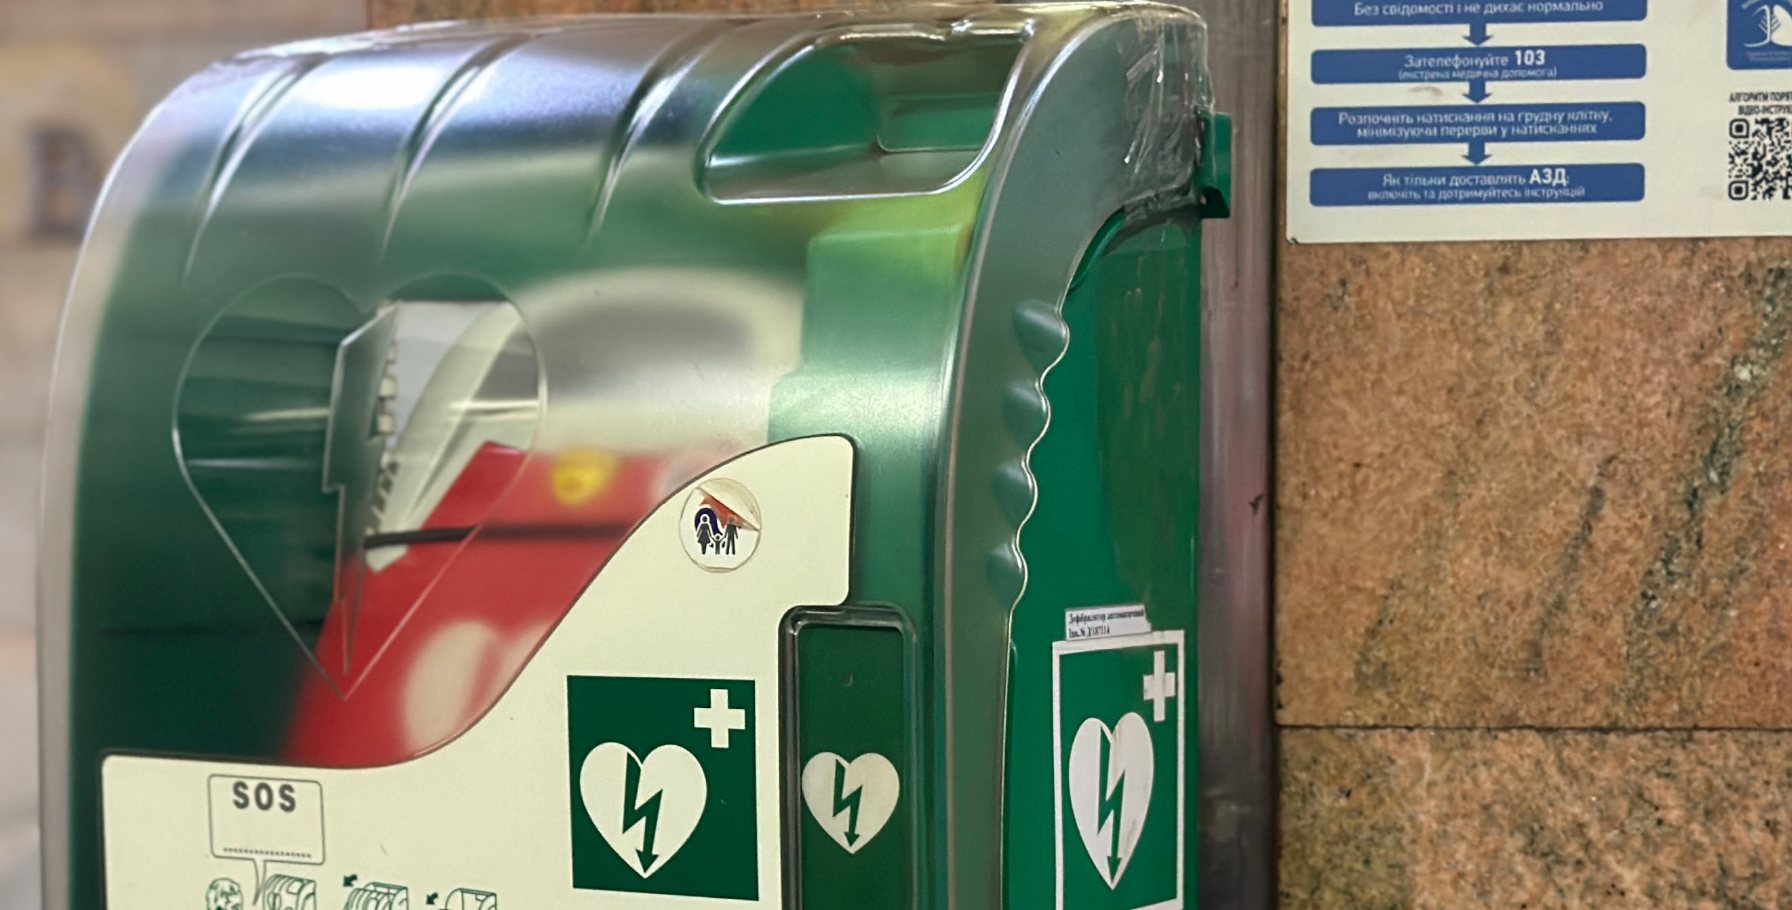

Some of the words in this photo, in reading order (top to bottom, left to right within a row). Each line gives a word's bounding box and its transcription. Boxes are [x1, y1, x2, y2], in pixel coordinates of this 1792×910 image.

[1354, 2, 1379, 16] Без
[1382, 2, 1454, 17] свідомості
[1464, 4, 1480, 13] не
[1527, 2, 1604, 14] нормально
[1404, 53, 1508, 70] Зателефонуйте
[1515, 49, 1546, 66] 103
[1338, 112, 1414, 125] Розпочніть
[1417, 112, 1495, 124] натискання
[1498, 112, 1515, 122] на
[1517, 111, 1565, 124] грудну
[1356, 126, 1437, 140] мінімізуючи
[1440, 125, 1497, 138] перерви
[1501, 126, 1509, 138] у
[1511, 123, 1597, 136] натисканнях
[1403, 174, 1446, 186] тільки
[1449, 174, 1526, 187] доставлять
[1423, 189, 1436, 199] та
[1438, 186, 1521, 201] дотримуйтесь
[232, 780, 297, 813] SOS
